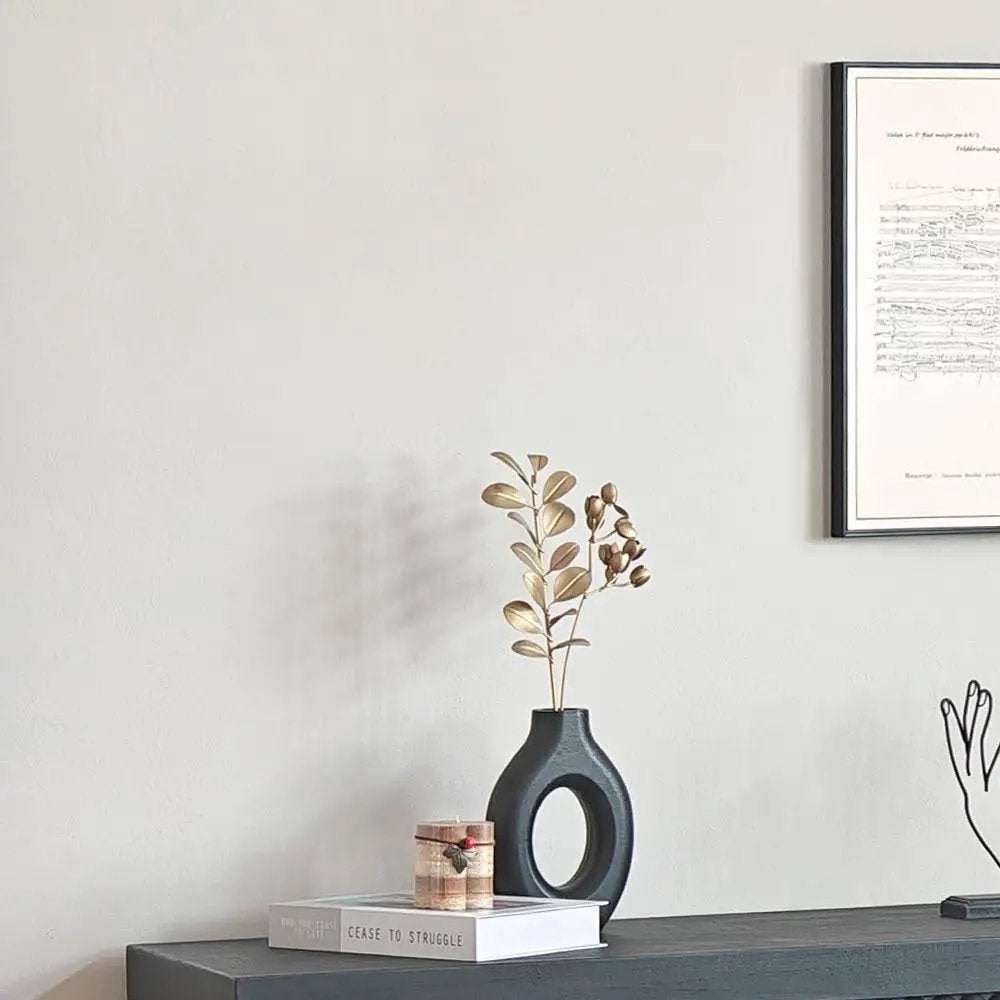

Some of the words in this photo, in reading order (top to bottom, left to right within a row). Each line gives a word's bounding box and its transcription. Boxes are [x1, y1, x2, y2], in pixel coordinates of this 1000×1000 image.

[348, 926, 381, 941] CEASE
[389, 929, 402, 942] TO
[409, 931, 463, 947] STRUGGLE
